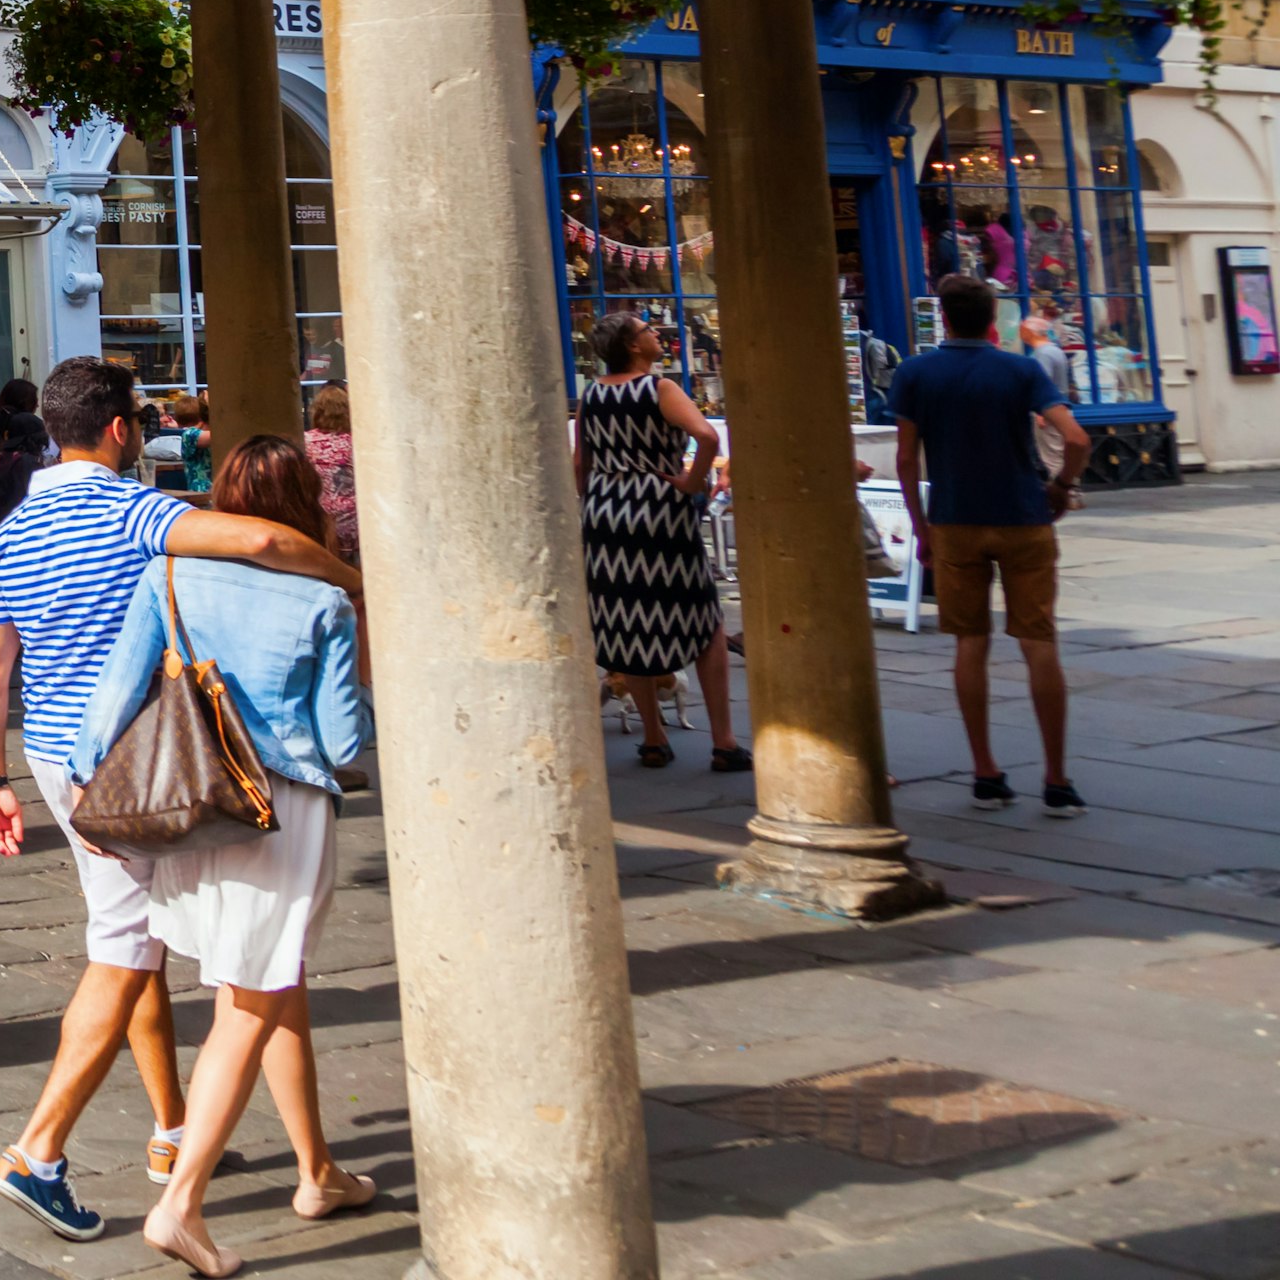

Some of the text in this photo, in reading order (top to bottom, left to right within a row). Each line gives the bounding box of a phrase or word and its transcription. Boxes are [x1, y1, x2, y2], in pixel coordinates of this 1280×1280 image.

[876, 23, 896, 46] of
[1016, 29, 1075, 56] BATH
[128, 202, 166, 211] CORNISH
[100, 211, 166, 224] BEST PASTY
[295, 210, 326, 219] COFFEE
